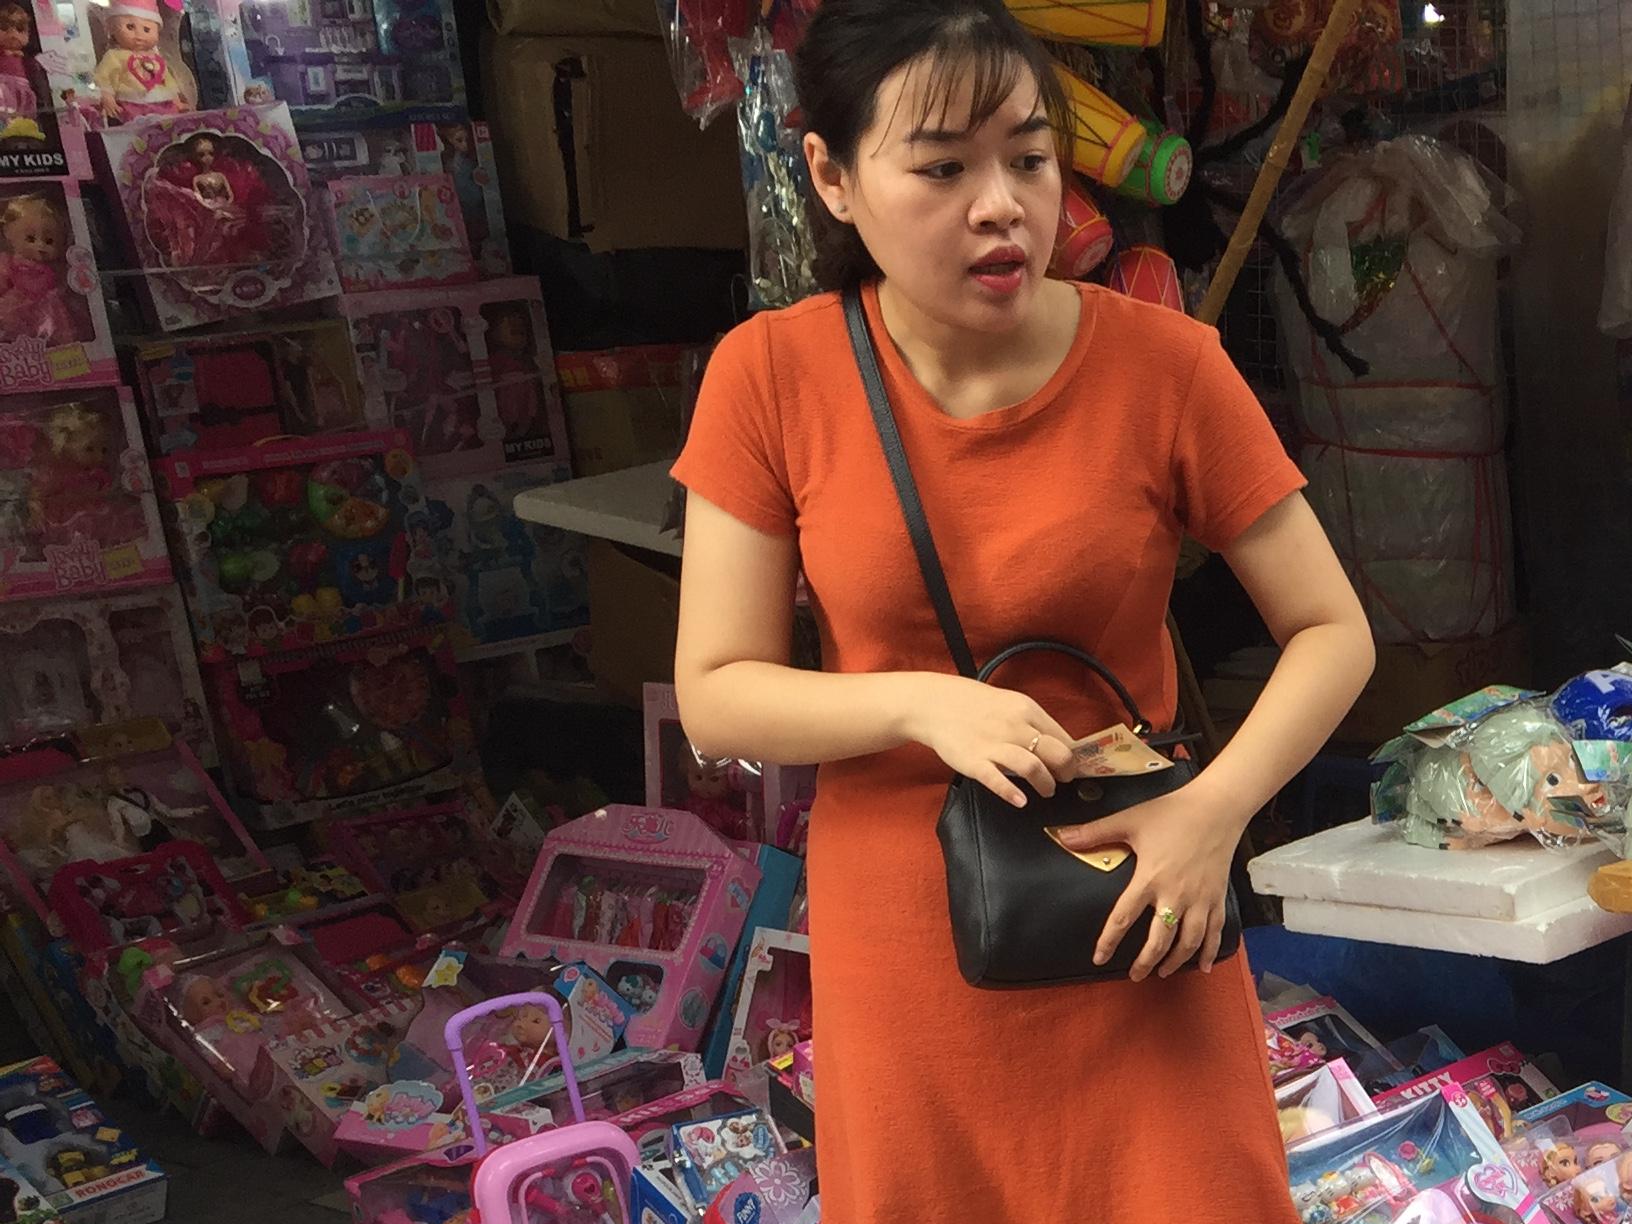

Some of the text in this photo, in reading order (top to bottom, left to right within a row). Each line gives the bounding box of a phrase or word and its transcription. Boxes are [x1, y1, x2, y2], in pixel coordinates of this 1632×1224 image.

[0, 152, 64, 168] MY KIDS
[1400, 1071, 1453, 1100] KITTY
